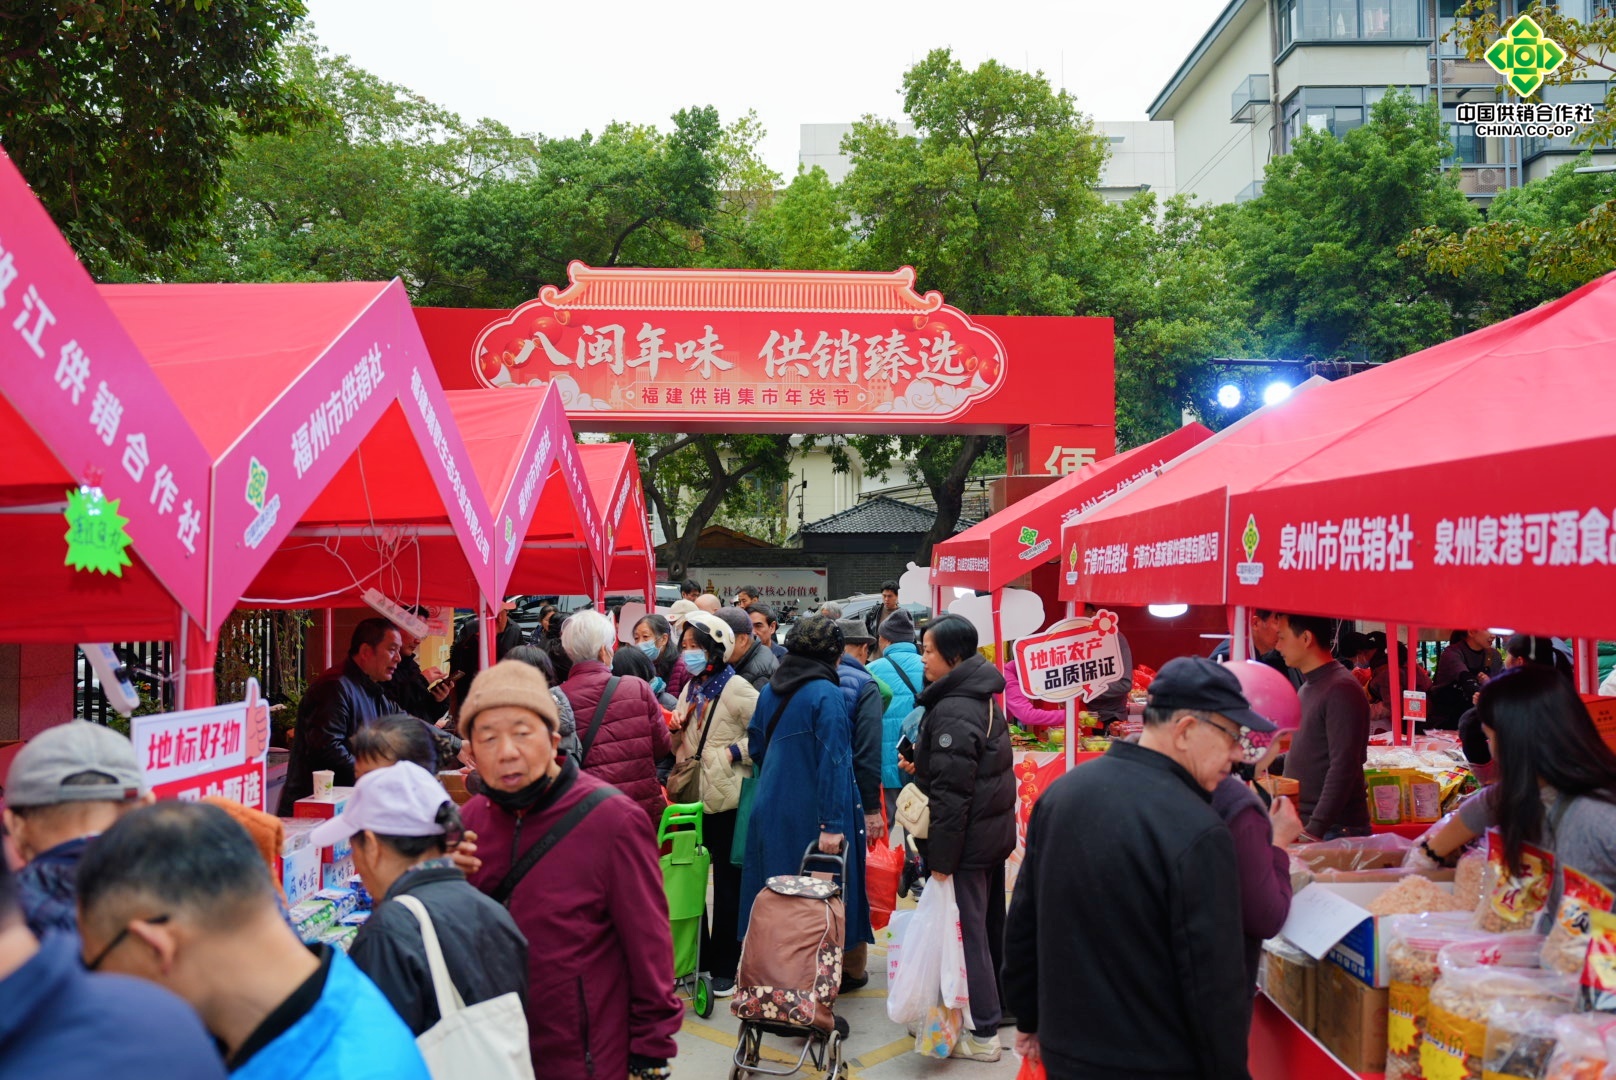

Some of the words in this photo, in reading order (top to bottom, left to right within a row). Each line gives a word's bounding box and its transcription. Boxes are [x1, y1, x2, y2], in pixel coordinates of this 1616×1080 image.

[514, 322, 735, 380] 八闽年味
[758, 328, 972, 385] 供销臻选
[291, 342, 385, 479] 福州市供销社
[641, 387, 849, 406] 福建供销集市年货节
[1084, 543, 1128, 575] 宁德市供销社
[1278, 514, 1414, 572] 泉州市供销社
[1434, 507, 1616, 566] 泉州泉港可源食
[1030, 637, 1103, 671] 地标农产
[1044, 656, 1116, 690] 品质保证
[146, 719, 241, 771] 地标好物
